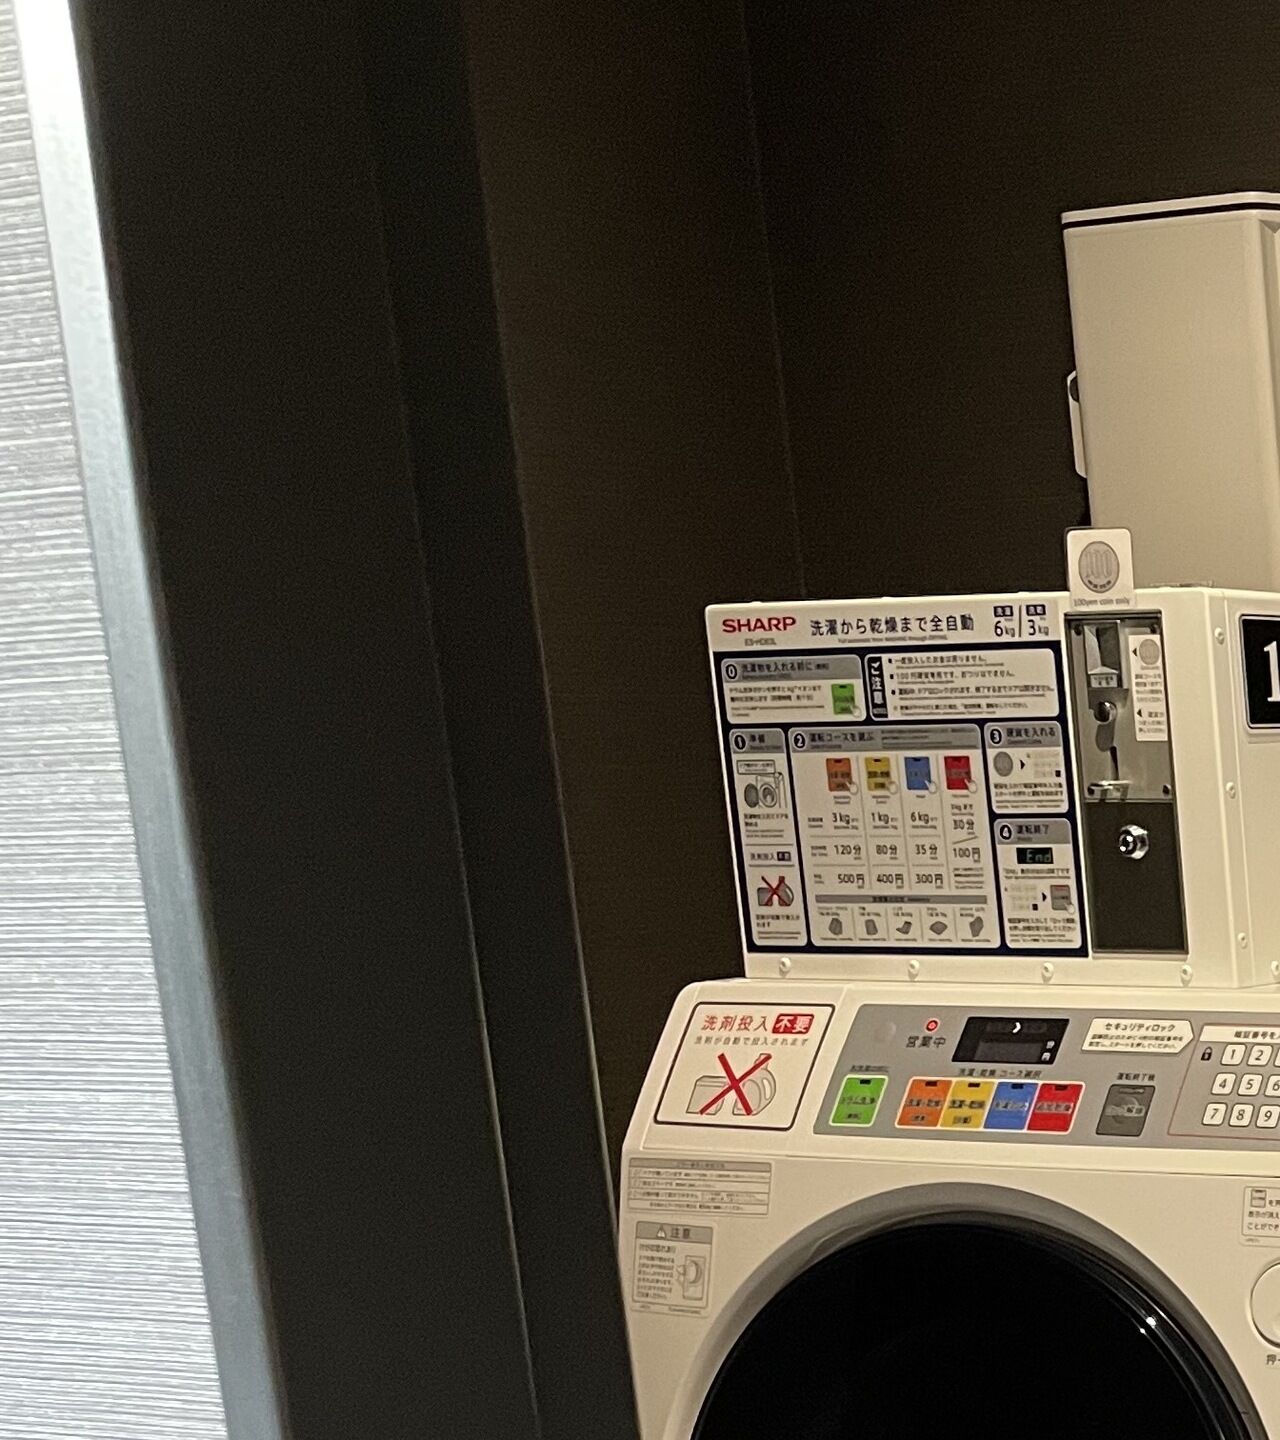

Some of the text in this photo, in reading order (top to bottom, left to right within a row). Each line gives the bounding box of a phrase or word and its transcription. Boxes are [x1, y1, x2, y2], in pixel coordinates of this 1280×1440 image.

[722, 616, 797, 633] SHARP
[810, 613, 974, 637] 洗濯から乾燥まで全自動
[1026, 849, 1051, 863] End
[701, 1014, 812, 1034] 洗剤投入 不要
[1104, 1022, 1175, 1033] セキュリティロック
[694, 1036, 809, 1047] 洗剤が自動で投入されます
[905, 1035, 946, 1049] 営業中
[1229, 1049, 1236, 1059] 1
[1255, 1050, 1264, 1061] 2
[1219, 1078, 1227, 1089] 4
[1246, 1079, 1254, 1090] 5
[1272, 1080, 1280, 1091] 6
[1210, 1108, 1219, 1119] 7
[1236, 1109, 1245, 1120] 8
[1264, 1110, 1272, 1122] 9
